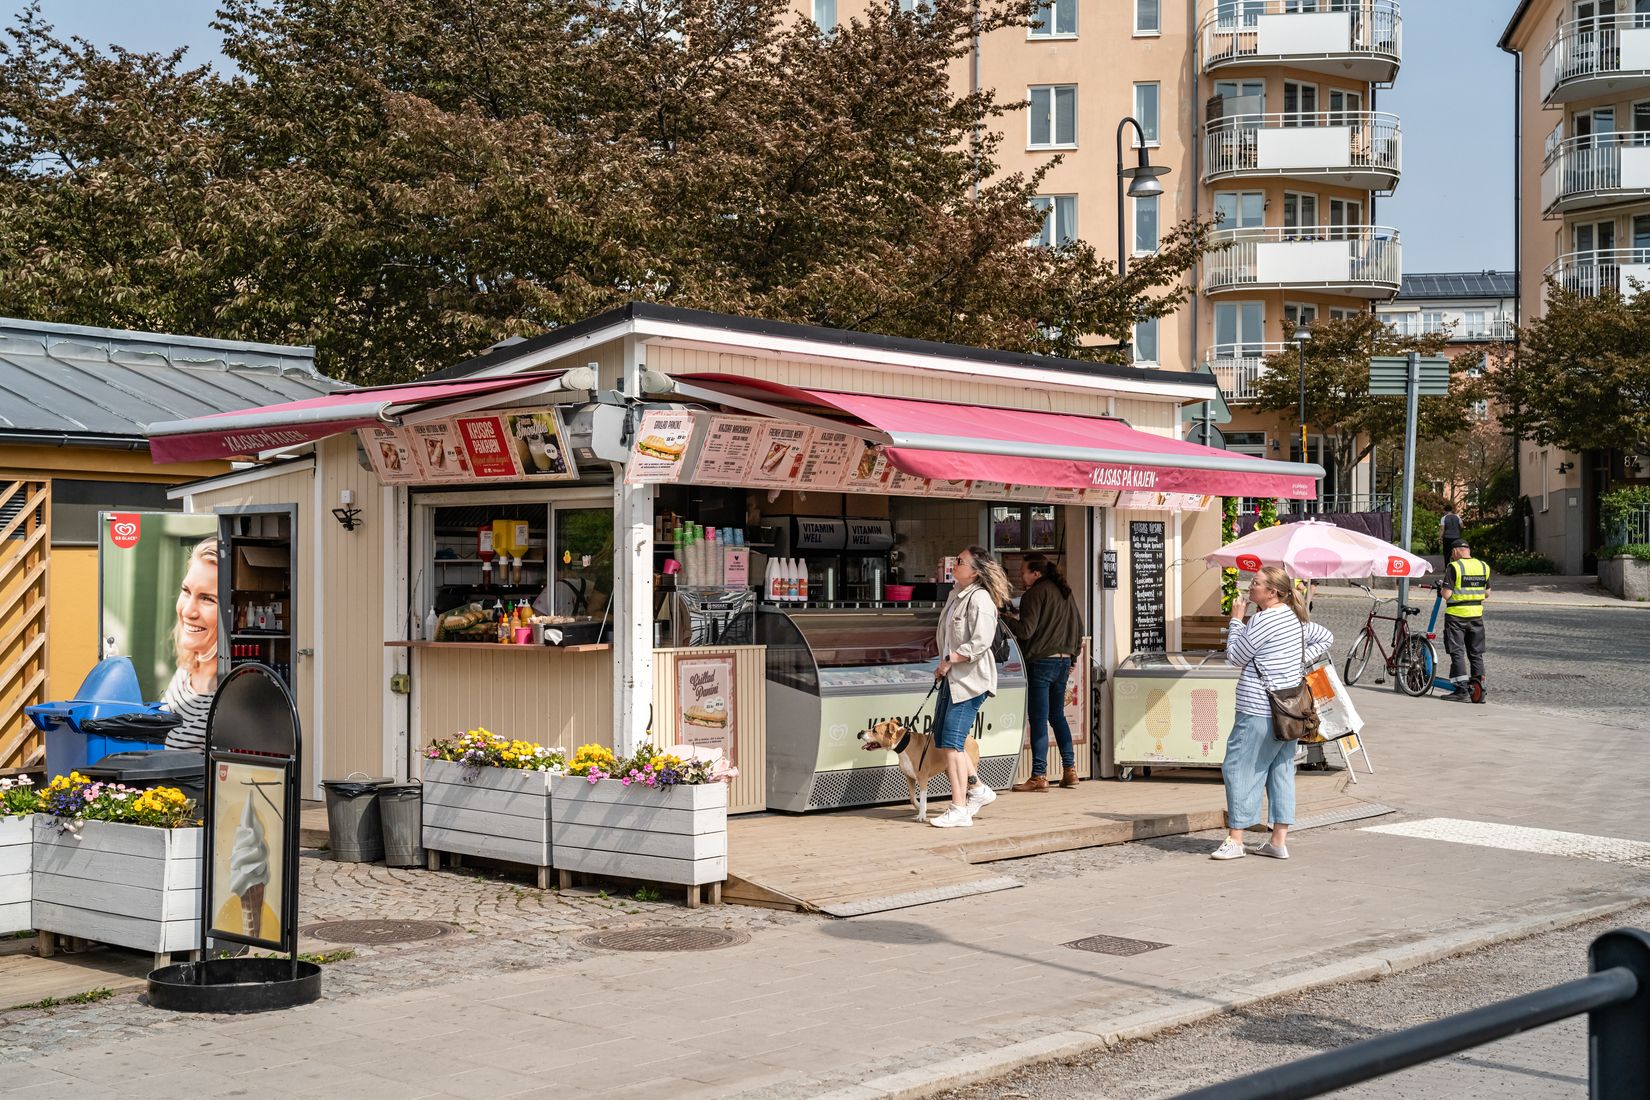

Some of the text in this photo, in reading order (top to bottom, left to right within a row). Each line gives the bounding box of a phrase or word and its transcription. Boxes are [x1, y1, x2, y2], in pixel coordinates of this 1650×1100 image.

[467, 421, 495, 439] KAJSAS
[224, 430, 305, 452] KAJSAS PÅ KAJEN
[1624, 456, 1638, 467] 87
[1092, 466, 1156, 488] KAJSAS PÅ KAJEN
[803, 523, 835, 534] VITAMIN
[852, 525, 882, 535] VITAMIN
[803, 533, 822, 543] WELL
[852, 535, 870, 545] WELL
[690, 669, 716, 691] Grillad
[695, 682, 720, 702] Panini
